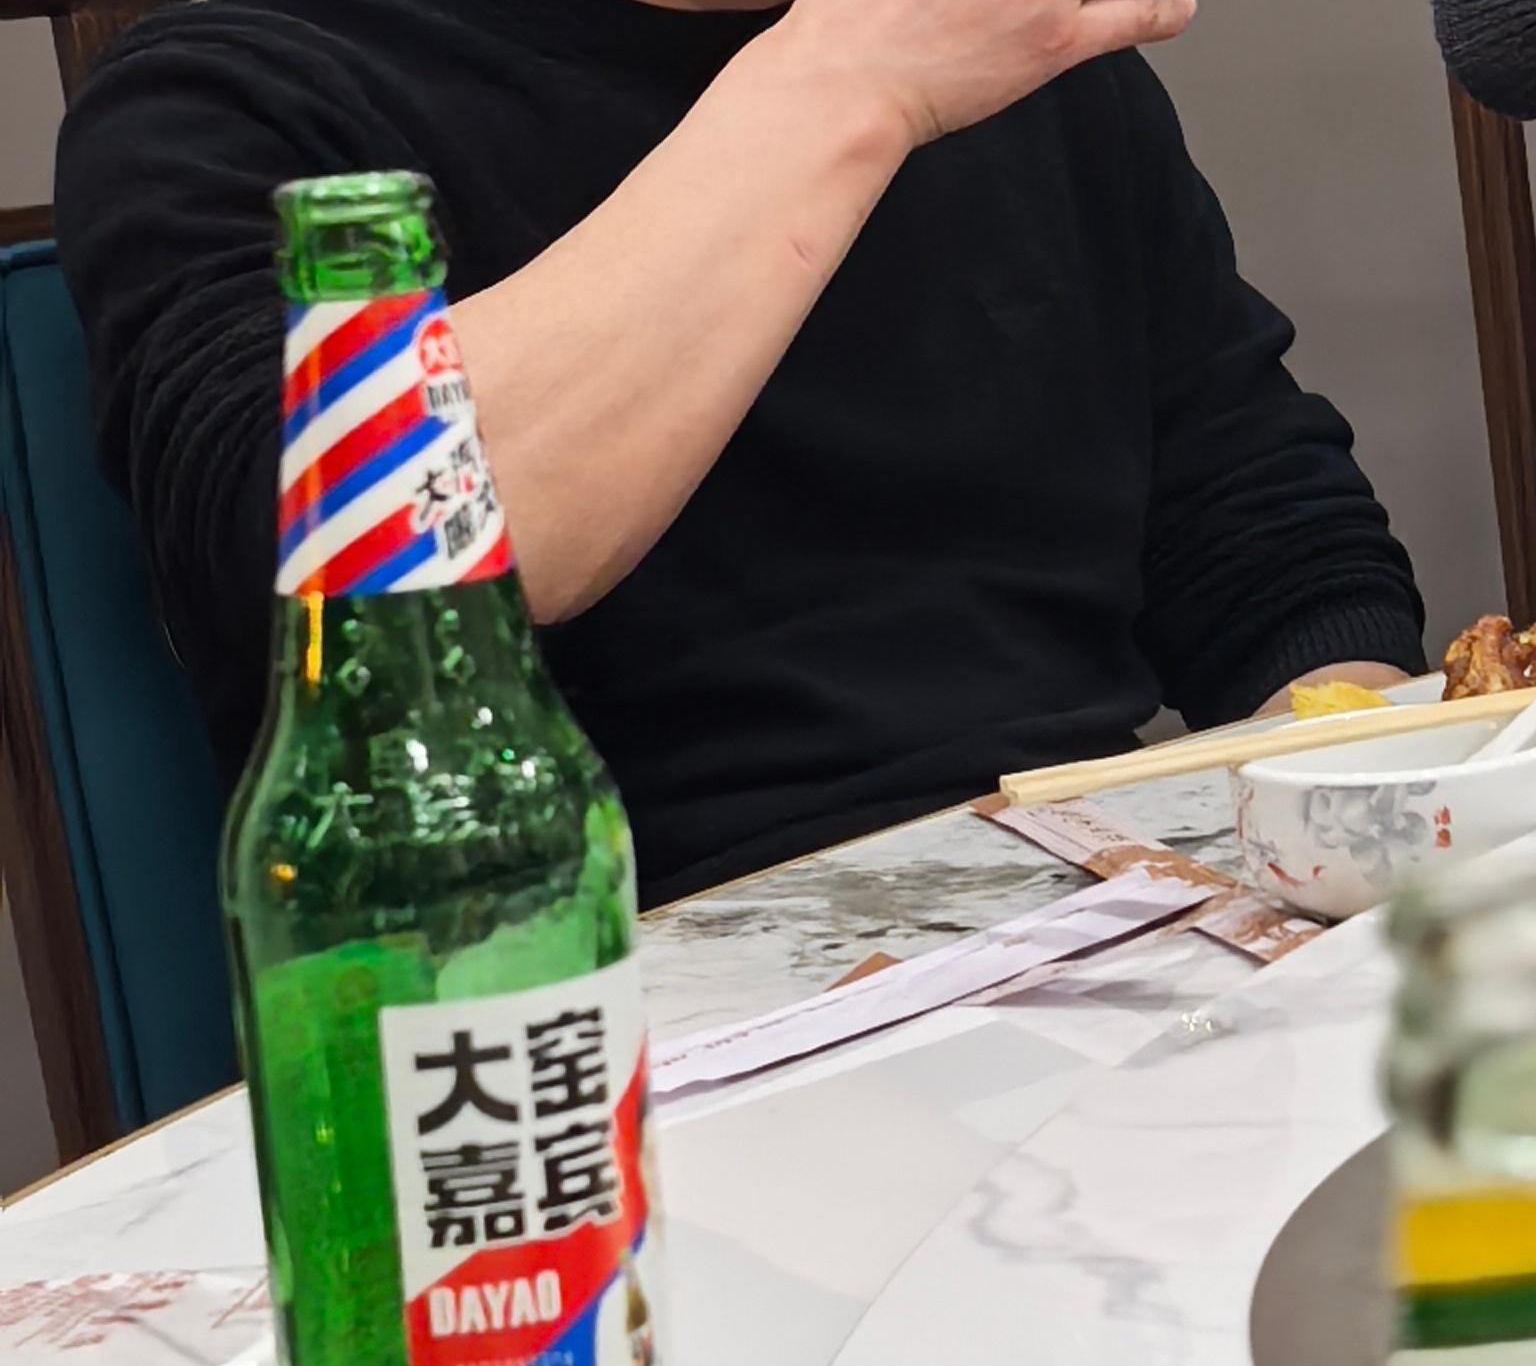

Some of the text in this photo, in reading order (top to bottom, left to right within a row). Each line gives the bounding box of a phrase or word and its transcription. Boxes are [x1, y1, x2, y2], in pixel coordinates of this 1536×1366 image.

[413, 1006, 608, 1135] 大窑
[419, 1122, 616, 1249] 嘉宾
[428, 1269, 562, 1339] DAYAO
